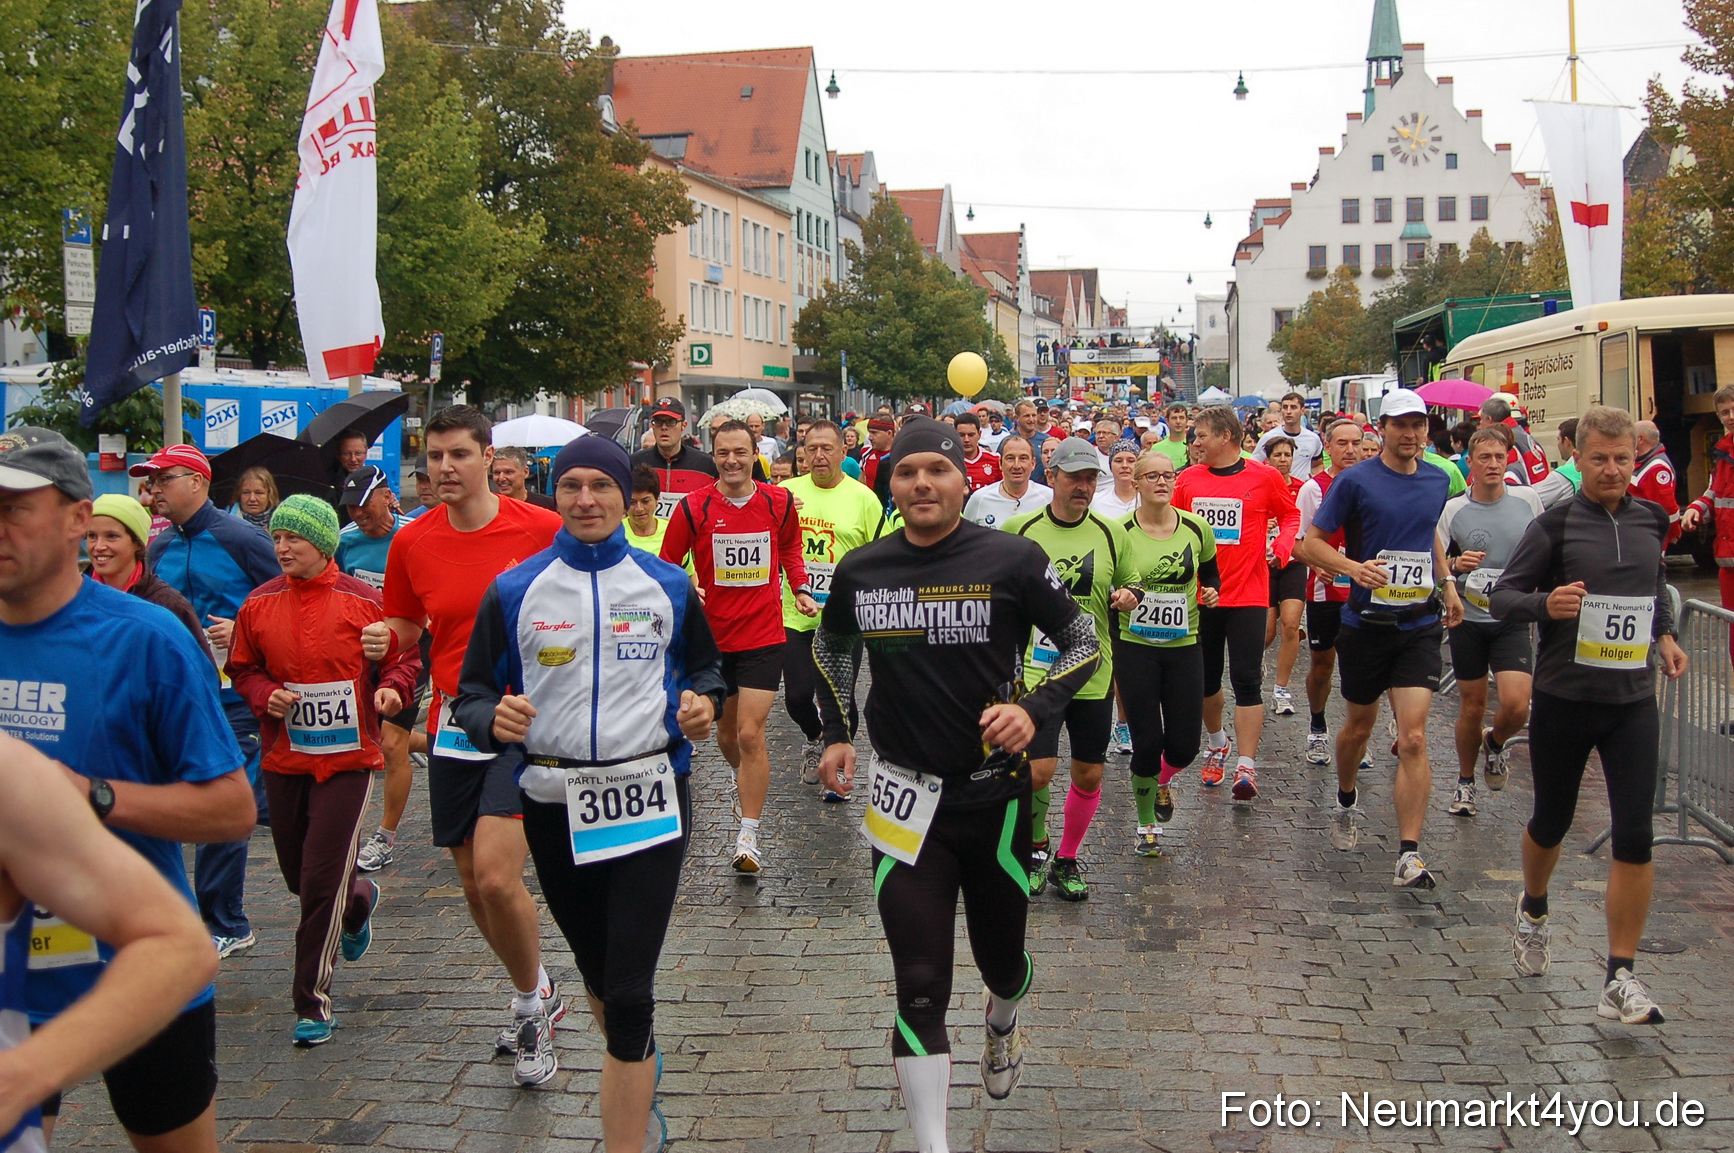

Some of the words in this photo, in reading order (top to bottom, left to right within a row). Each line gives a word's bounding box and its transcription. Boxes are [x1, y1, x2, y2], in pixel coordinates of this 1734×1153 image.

[203, 314, 212, 341] P
[693, 346, 709, 363] D
[1098, 366, 1129, 374] START
[1524, 352, 1573, 380] Bayerisches
[1523, 381, 1547, 401] Rotes
[799, 516, 835, 529] Müller
[806, 538, 825, 555] M
[725, 546, 761, 566] 504
[1378, 554, 1398, 562] PARTL
[1399, 556, 1426, 564] Neumarkt
[725, 570, 760, 579] Bernhard
[1389, 564, 1423, 585] 179
[918, 585, 965, 594] HAMBURG
[968, 584, 991, 592] 2012
[1388, 589, 1416, 598] Marcus
[1154, 597, 1179, 605] Neumarkt
[1583, 600, 1611, 610] PARTL
[1612, 603, 1646, 611] Neumarkt
[610, 611, 652, 622] PANORAMA
[855, 599, 991, 631] URBANATHLON
[1136, 605, 1184, 626] 2460
[531, 620, 576, 632] Bergler
[612, 621, 630, 632] TOUR
[1140, 628, 1177, 638] Alexandra
[1604, 614, 1637, 641] 56
[927, 628, 937, 644] &
[938, 627, 990, 644] FESTIVAL
[1599, 646, 1634, 661] Holger
[304, 689, 341, 698] Neumarkt
[291, 699, 351, 727] 2054
[25, 731, 60, 742] Solutions
[303, 733, 337, 744] Marina
[567, 776, 604, 787] PARTL
[605, 768, 655, 784] Neumarkt
[578, 779, 668, 824] 3084
[872, 773, 917, 821] 550
